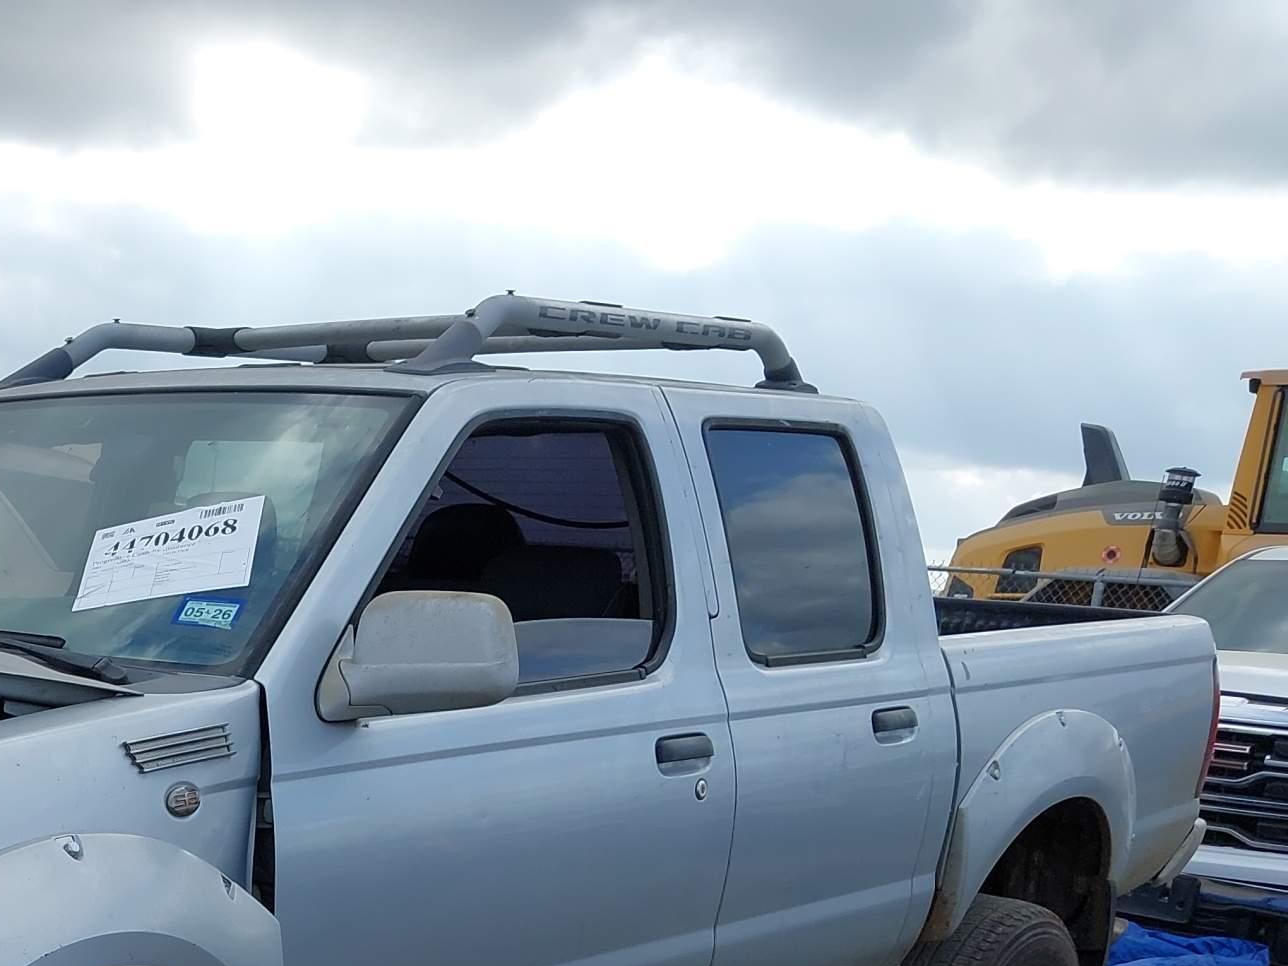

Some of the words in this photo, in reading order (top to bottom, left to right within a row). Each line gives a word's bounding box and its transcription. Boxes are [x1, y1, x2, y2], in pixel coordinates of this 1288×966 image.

[538, 305, 661, 331] CREW
[675, 320, 753, 341] CAB
[1113, 511, 1183, 521] VOLV
[104, 518, 239, 556] 44704068
[184, 607, 205, 618] 05
[211, 608, 233, 620] 26
